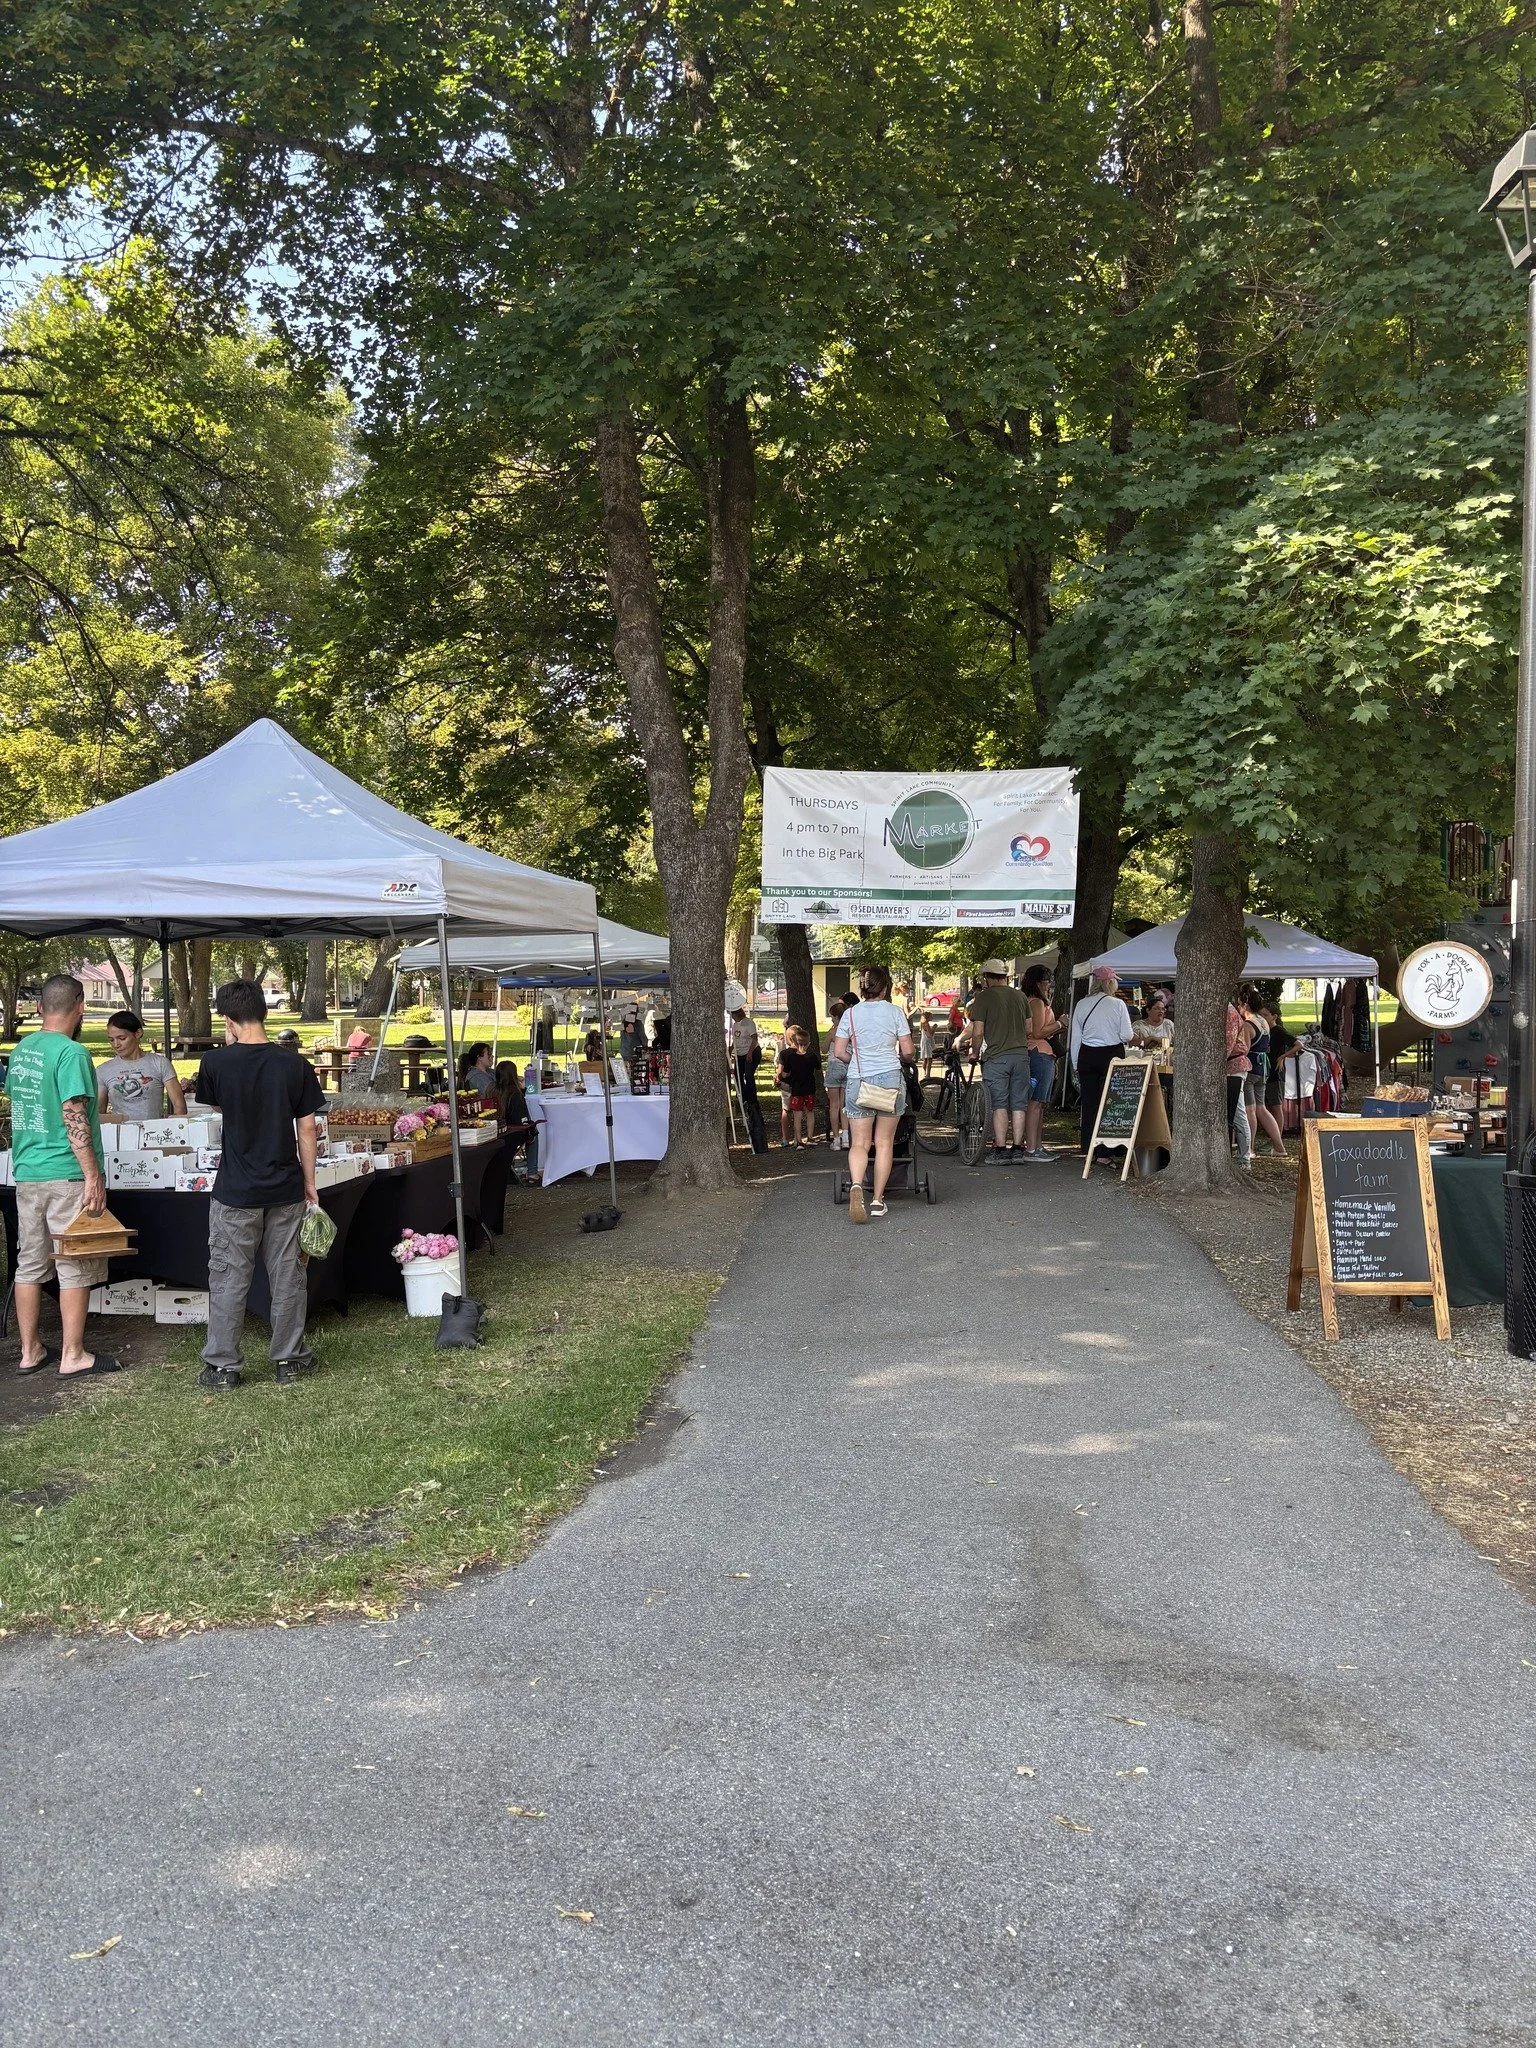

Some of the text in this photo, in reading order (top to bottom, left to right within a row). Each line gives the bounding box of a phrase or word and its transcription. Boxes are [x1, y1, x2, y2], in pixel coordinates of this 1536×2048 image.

[891, 780, 955, 807] SPIRIT LAKE COMMUNITY
[789, 796, 859, 810] THURSDAYS
[786, 822, 859, 836] 4 pm to 7 pm
[782, 847, 864, 860] In the Big Park
[766, 888, 790, 896] Thank
[833, 889, 872, 898] Sponsors!
[858, 905, 909, 914] SEDLMAYER'S
[1024, 904, 1068, 913] MAINE ST
[1418, 958, 1430, 972] FOX
[1446, 952, 1473, 973] DOODLE
[1428, 1010, 1455, 1019] FARMS
[1328, 1134, 1408, 1178] foxadoodle
[1354, 1163, 1392, 1188] farm
[1334, 1199, 1396, 1212] Homemade Vanilla
[1334, 1211, 1346, 1221] High
[1367, 1212, 1386, 1222] Bagels
[1335, 1229, 1352, 1237] Protein
[1336, 1239, 1348, 1248] Eggs
[1336, 1256, 1358, 1266] Foaming
